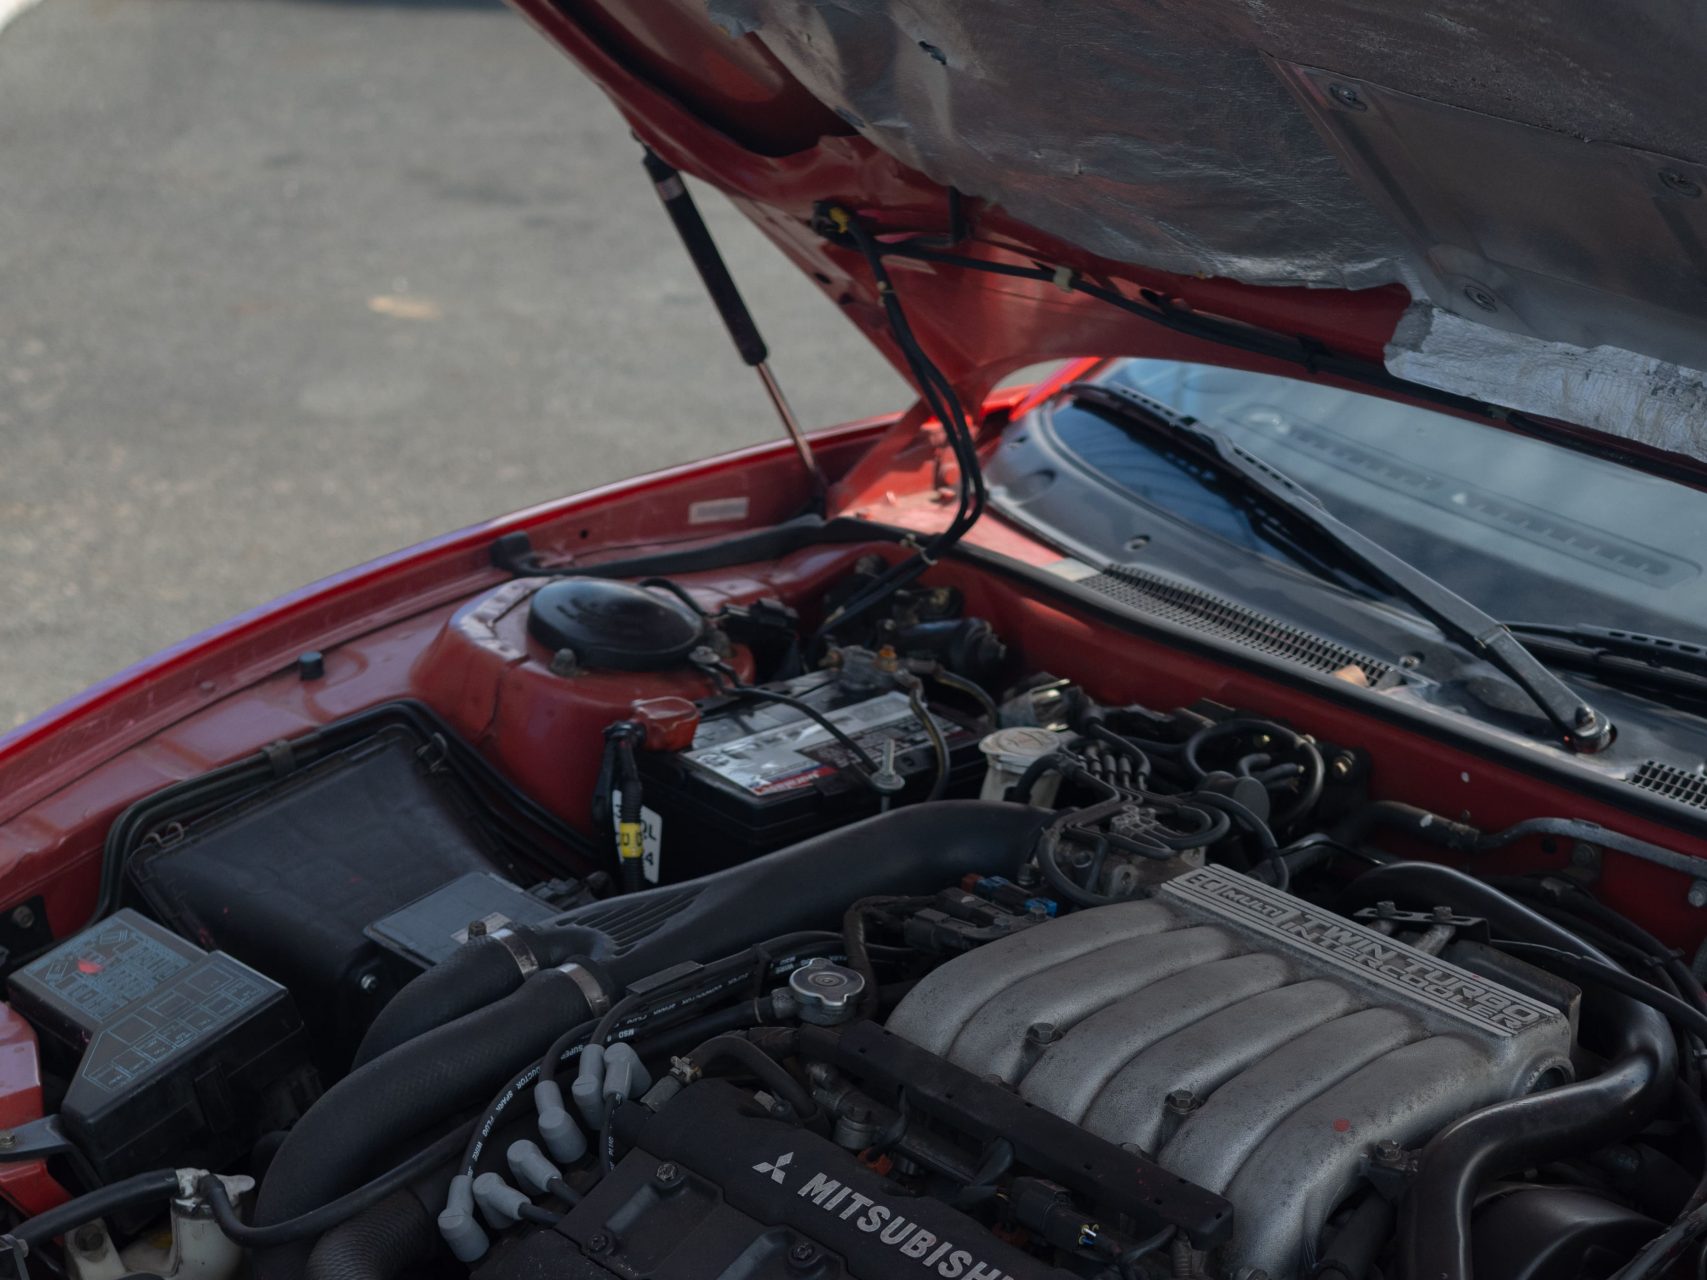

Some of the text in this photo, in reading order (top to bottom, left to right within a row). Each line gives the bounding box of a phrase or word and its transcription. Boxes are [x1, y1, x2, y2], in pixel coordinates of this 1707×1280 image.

[1218, 887, 1287, 919] MULTI
[1278, 920, 1525, 1030] INTERCOOLER
[1291, 913, 1542, 1024] TWIN TURBO
[516, 1066, 541, 1091] DUCTOR
